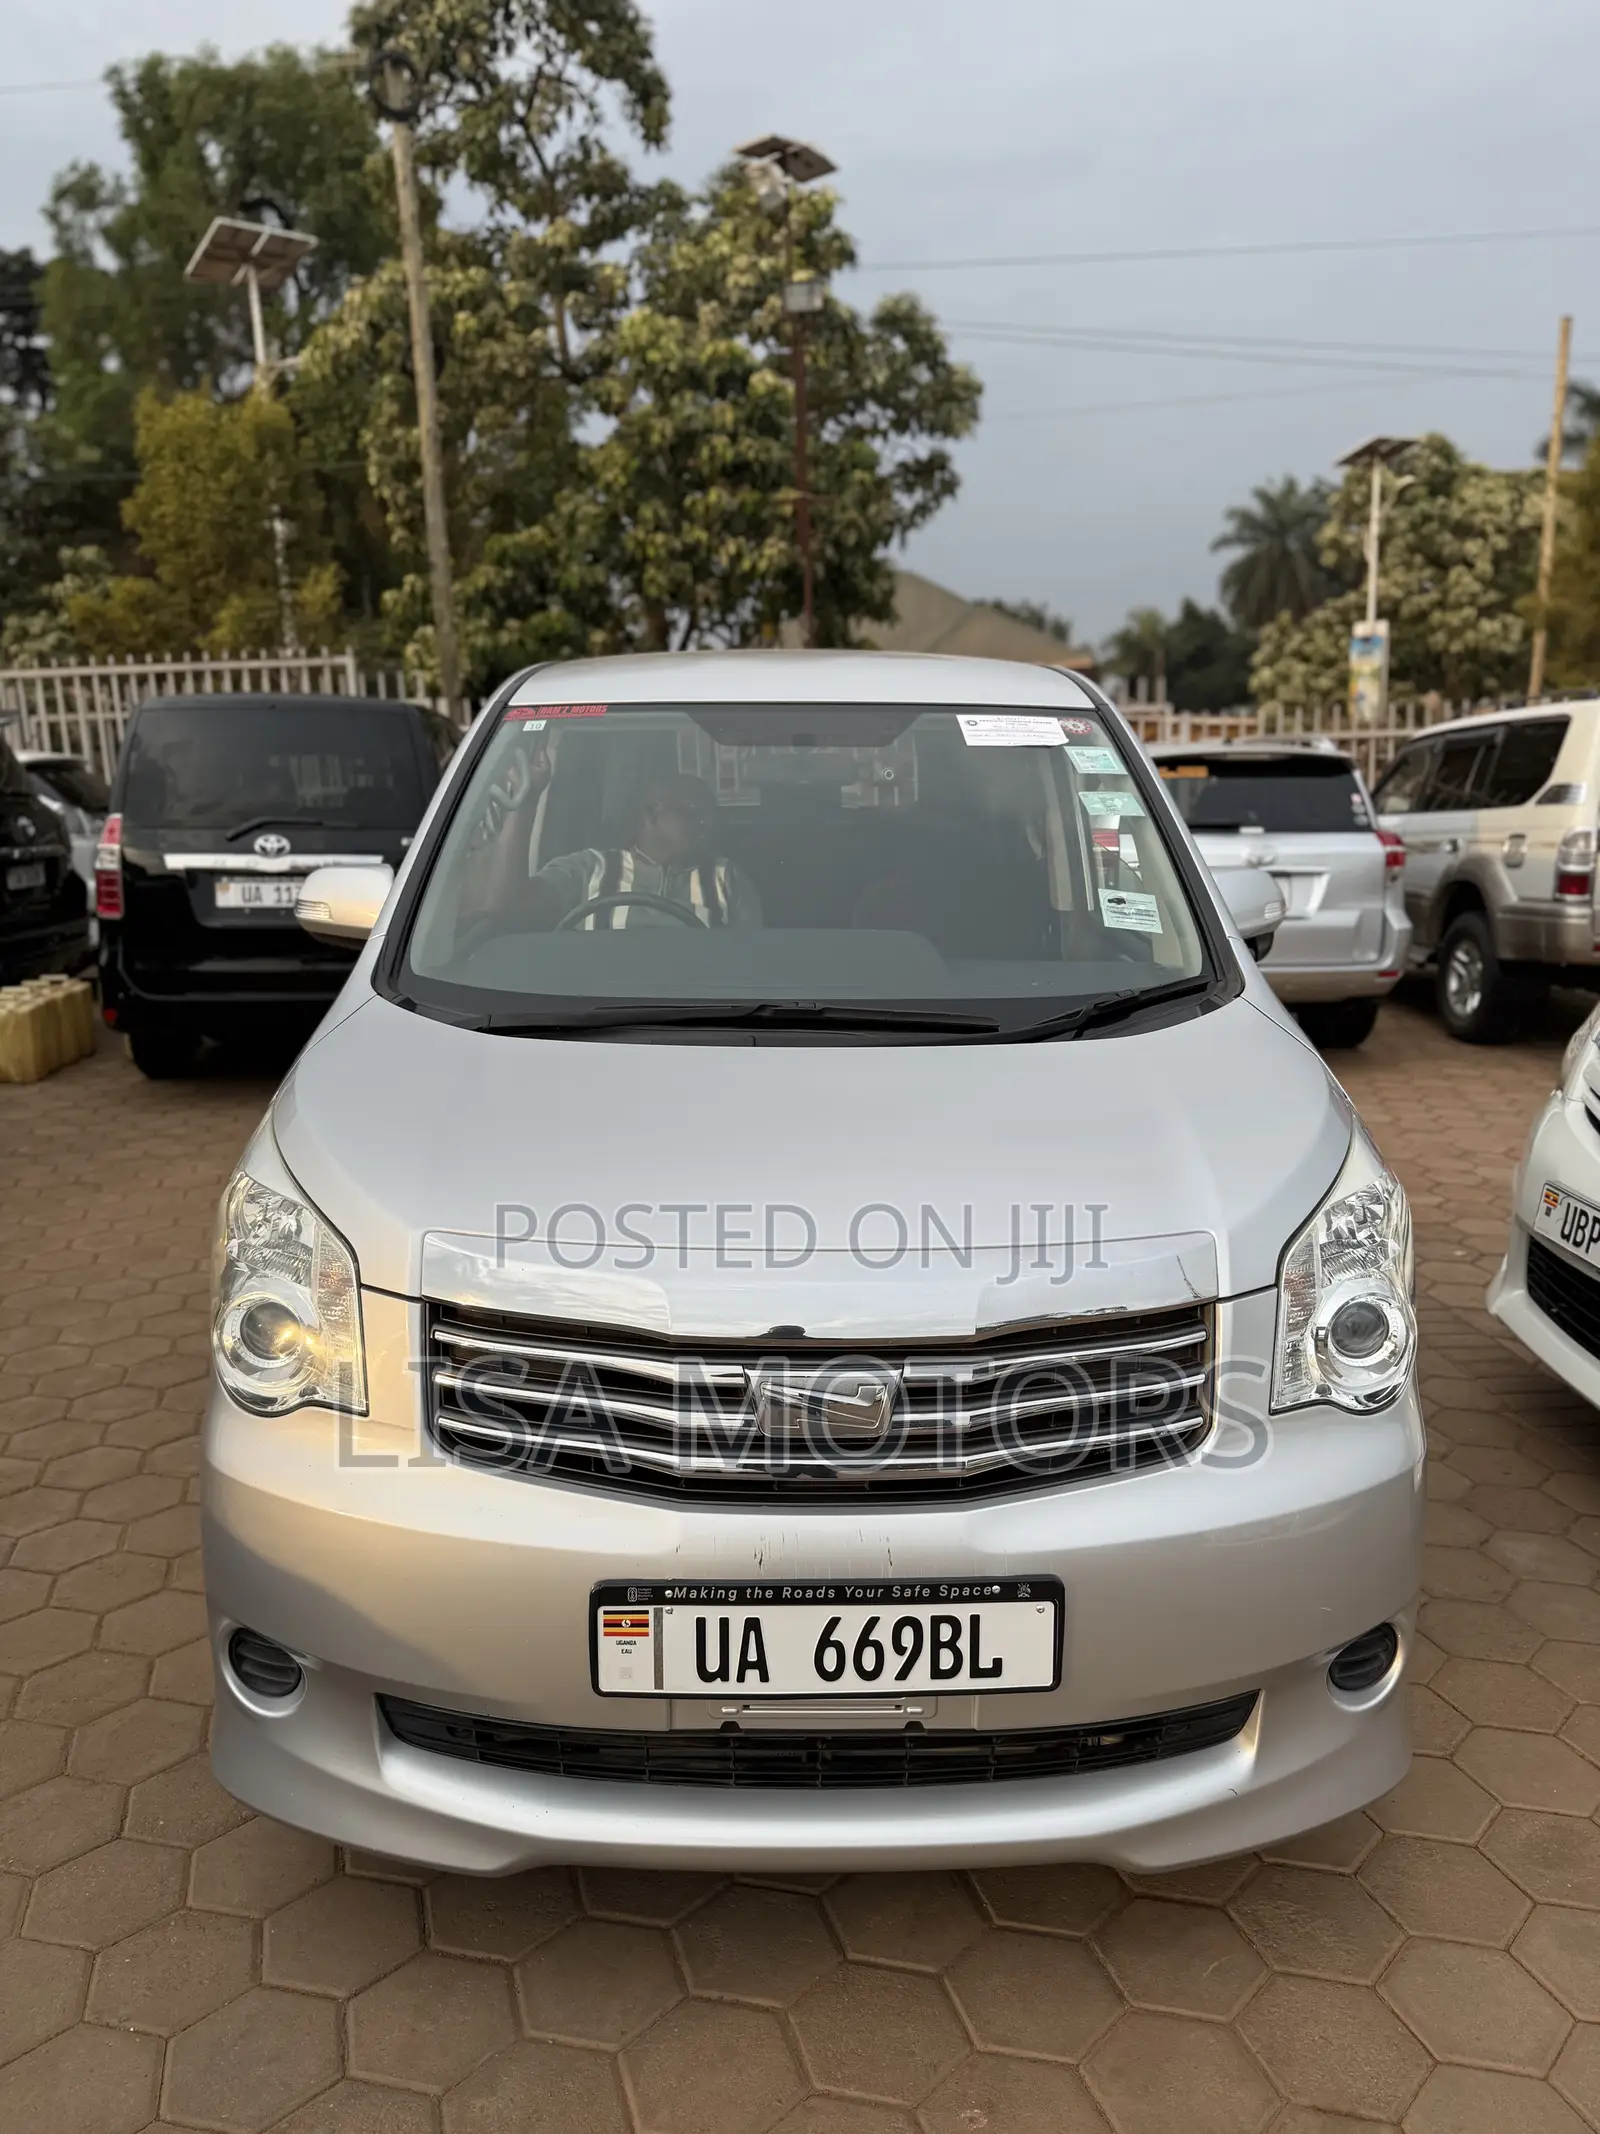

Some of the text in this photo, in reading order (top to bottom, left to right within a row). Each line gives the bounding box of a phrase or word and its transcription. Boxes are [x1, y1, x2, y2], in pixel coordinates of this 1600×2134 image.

[571, 705, 608, 714] MOTORS
[241, 885, 263, 904] UA
[1561, 1202, 1600, 1254] UBP
[673, 1584, 992, 1601] Making the Roads Your Safe Space
[695, 1613, 1003, 1683] UA 669BL
